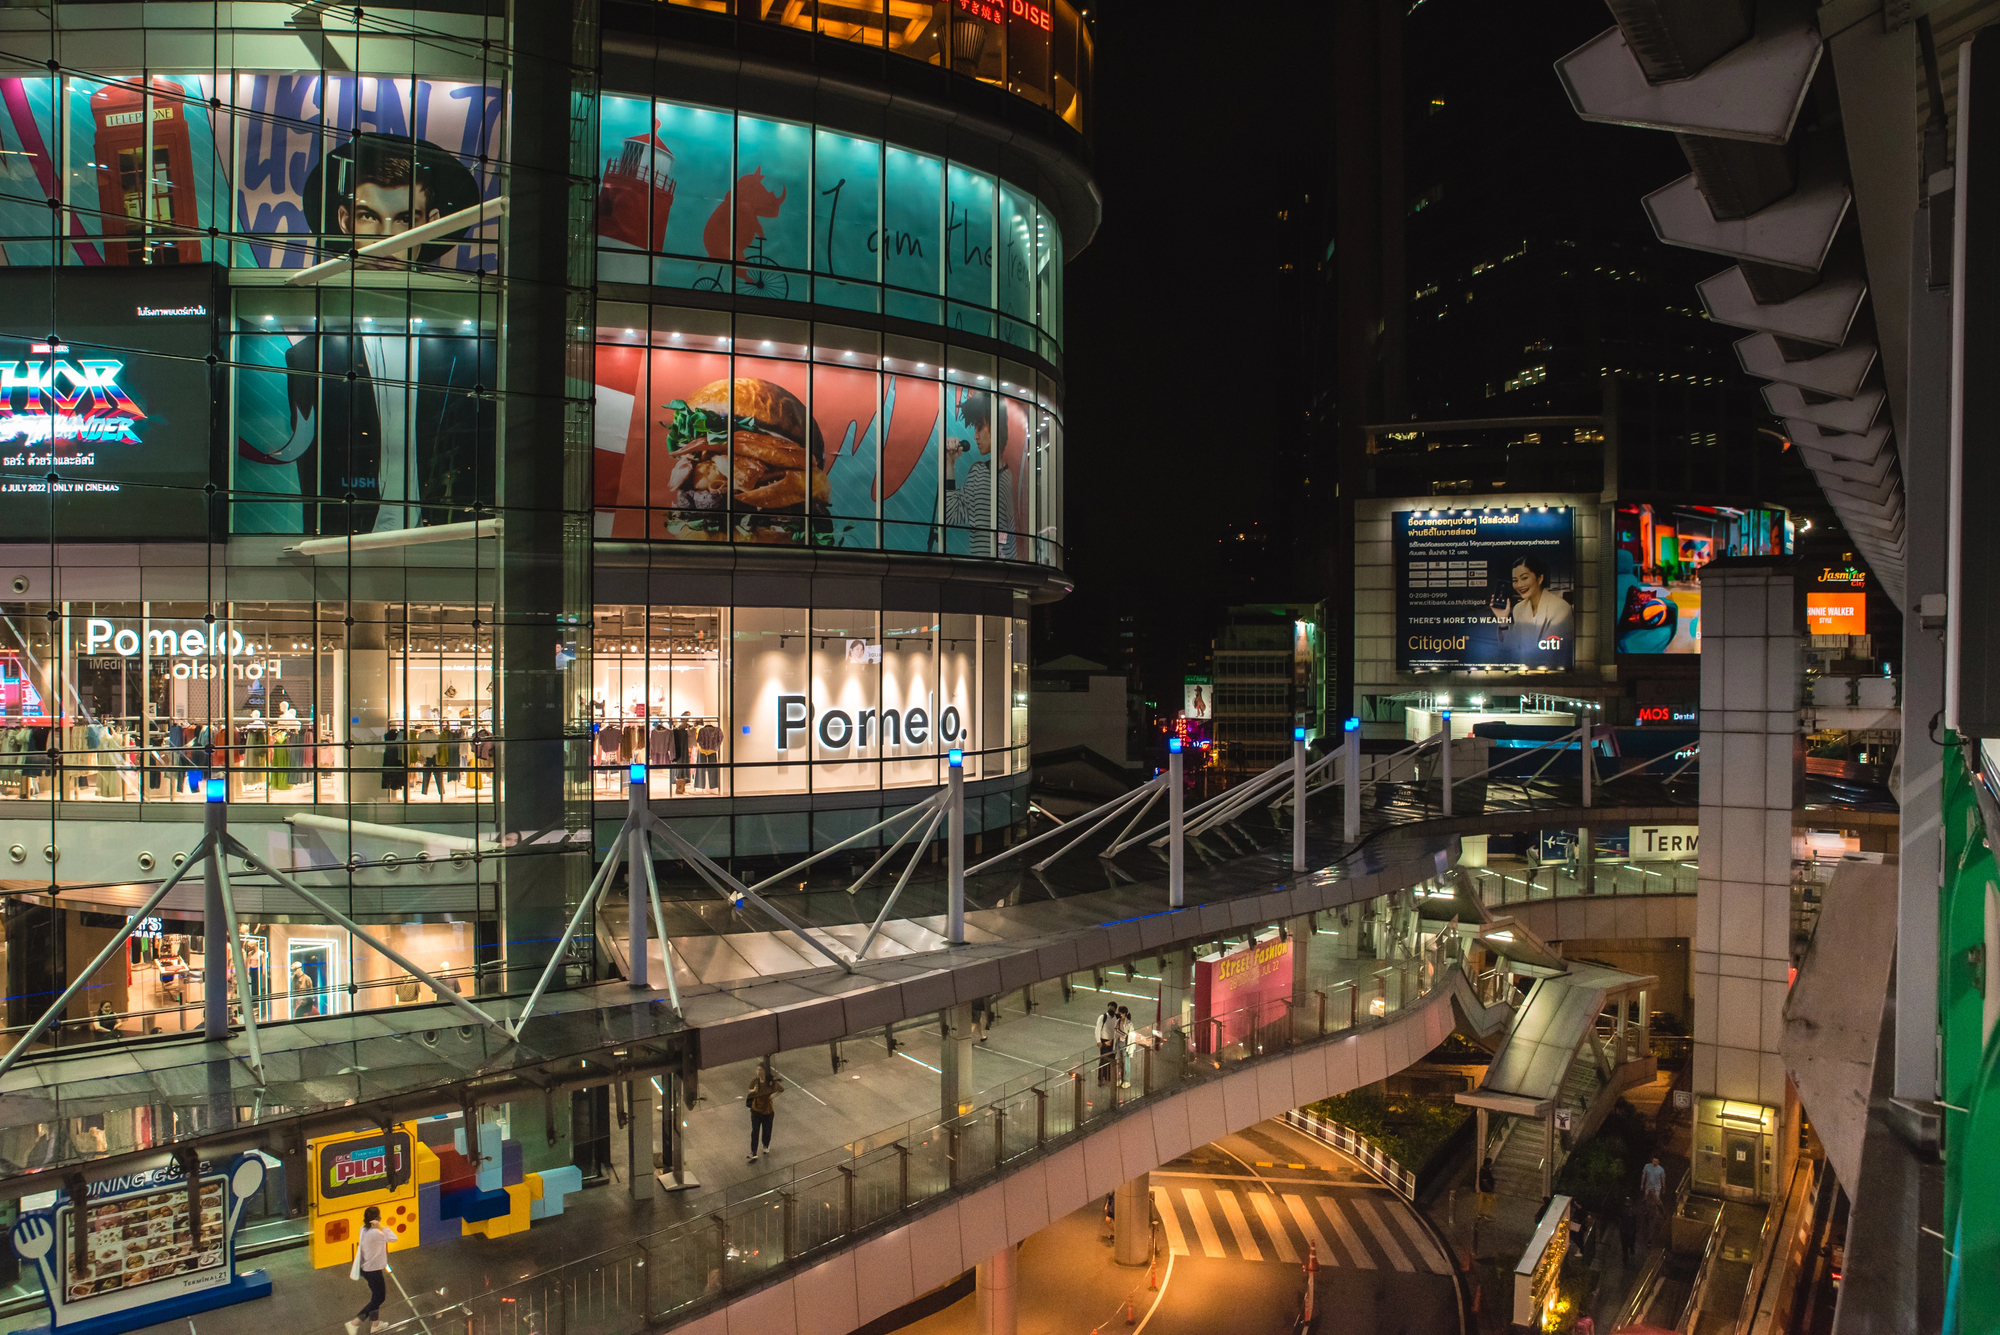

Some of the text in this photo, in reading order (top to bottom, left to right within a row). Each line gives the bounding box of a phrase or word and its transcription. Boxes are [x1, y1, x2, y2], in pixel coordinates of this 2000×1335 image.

[867, 227, 923, 261] am
[947, 201, 993, 276] the
[0, 359, 148, 419] HOR
[8, 484, 27, 492] JULY
[28, 484, 46, 492] 2022
[53, 484, 74, 492] ONLY
[75, 484, 84, 492] IN
[85, 484, 120, 492] CINEMAS
[341, 476, 376, 489] LUSH
[1828, 607, 1854, 616] WALKER
[1479, 616, 1512, 624] WEALTH
[1538, 636, 1560, 650] citi
[1639, 707, 1695, 721] MOS Dental
[1272, 959, 1279, 972] 22
